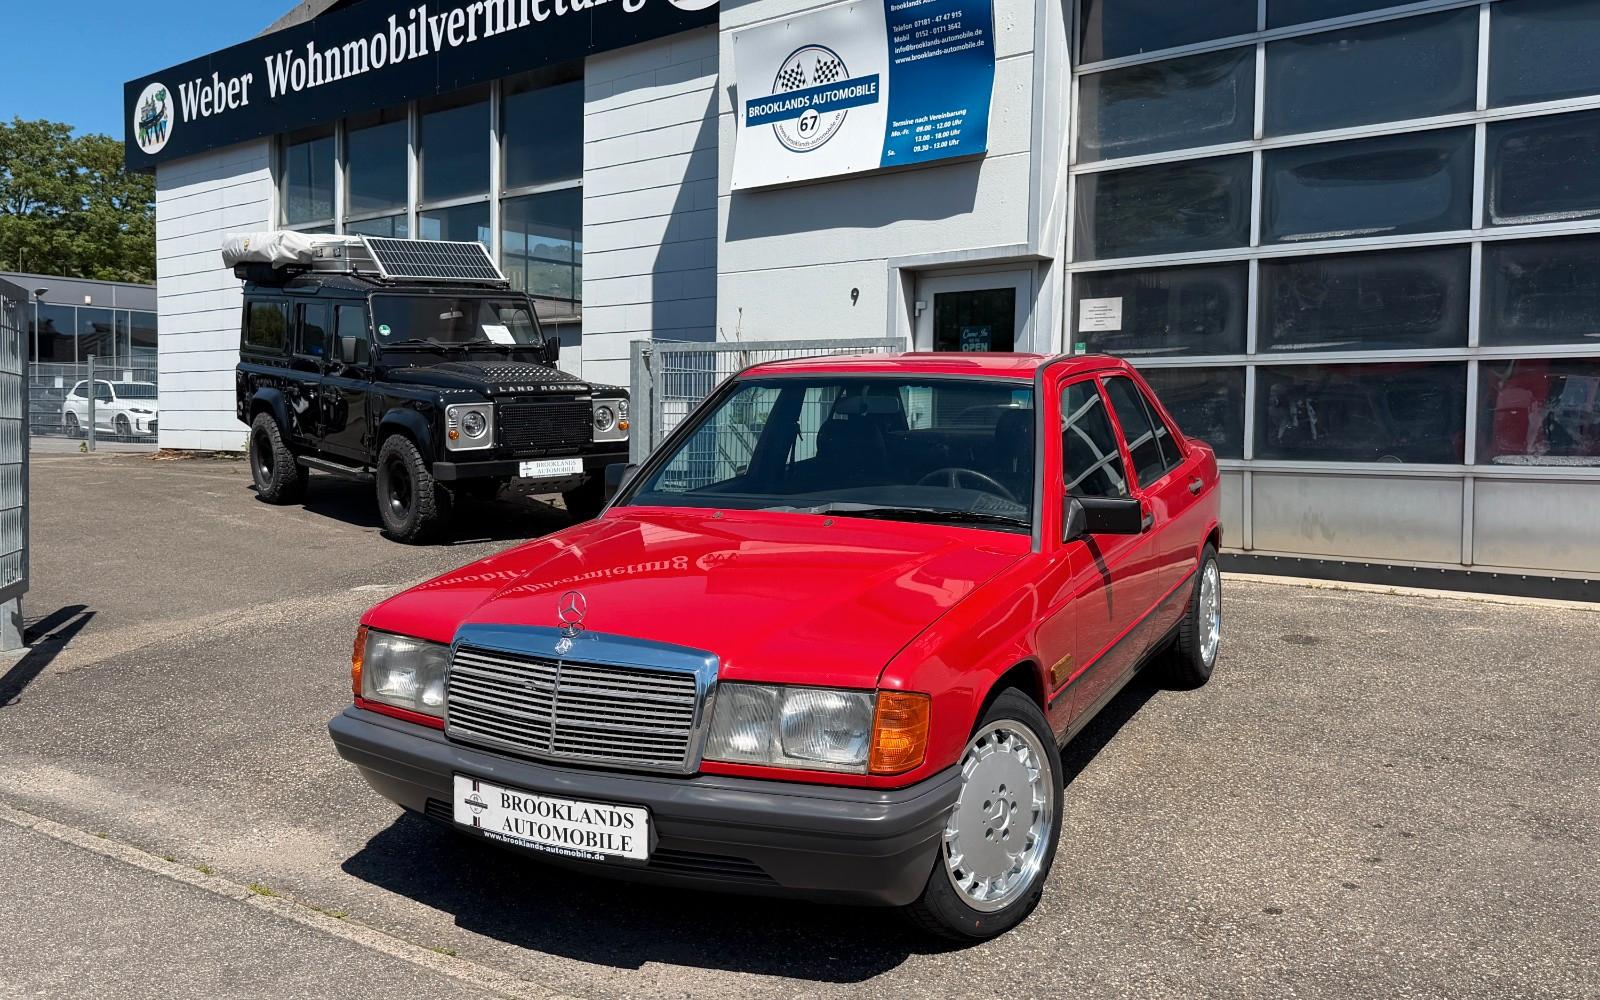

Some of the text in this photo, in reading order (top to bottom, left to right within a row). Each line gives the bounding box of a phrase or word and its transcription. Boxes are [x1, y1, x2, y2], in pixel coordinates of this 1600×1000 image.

[890, 0, 922, 12] Brooklands
[893, 23, 913, 33] Telefon
[914, 18, 930, 28] 07181
[935, 15, 943, 23] 47
[943, 13, 951, 21] 47
[951, 10, 962, 19] 915
[894, 33, 910, 43] Mobil
[915, 29, 929, 39] 0152
[933, 25, 947, 35] 0171
[178, 0, 646, 123] Weber Wohnmobilvermi
[894, 39, 985, 65] www.brooklands-automobile.de
[748, 82, 876, 118] BROOKLANDS AUTOMOBILE
[800, 115, 818, 132] 67
[892, 109, 967, 128] Termine nach Vereinbarung
[936, 121, 951, 129] 12.00
[951, 118, 963, 126] Uhr
[887, 149, 896, 157] Sa.
[933, 141, 948, 149] 13.00
[948, 138, 960, 146] Uhr
[914, 134, 930, 142] 13.00
[850, 287, 860, 307] 9
[962, 342, 988, 352] OPEN
[500, 792, 634, 830] BROOKLANDS
[502, 816, 633, 852] AUTOMOBILE
[483, 830, 605, 861] www.brooklands-automobile.de
